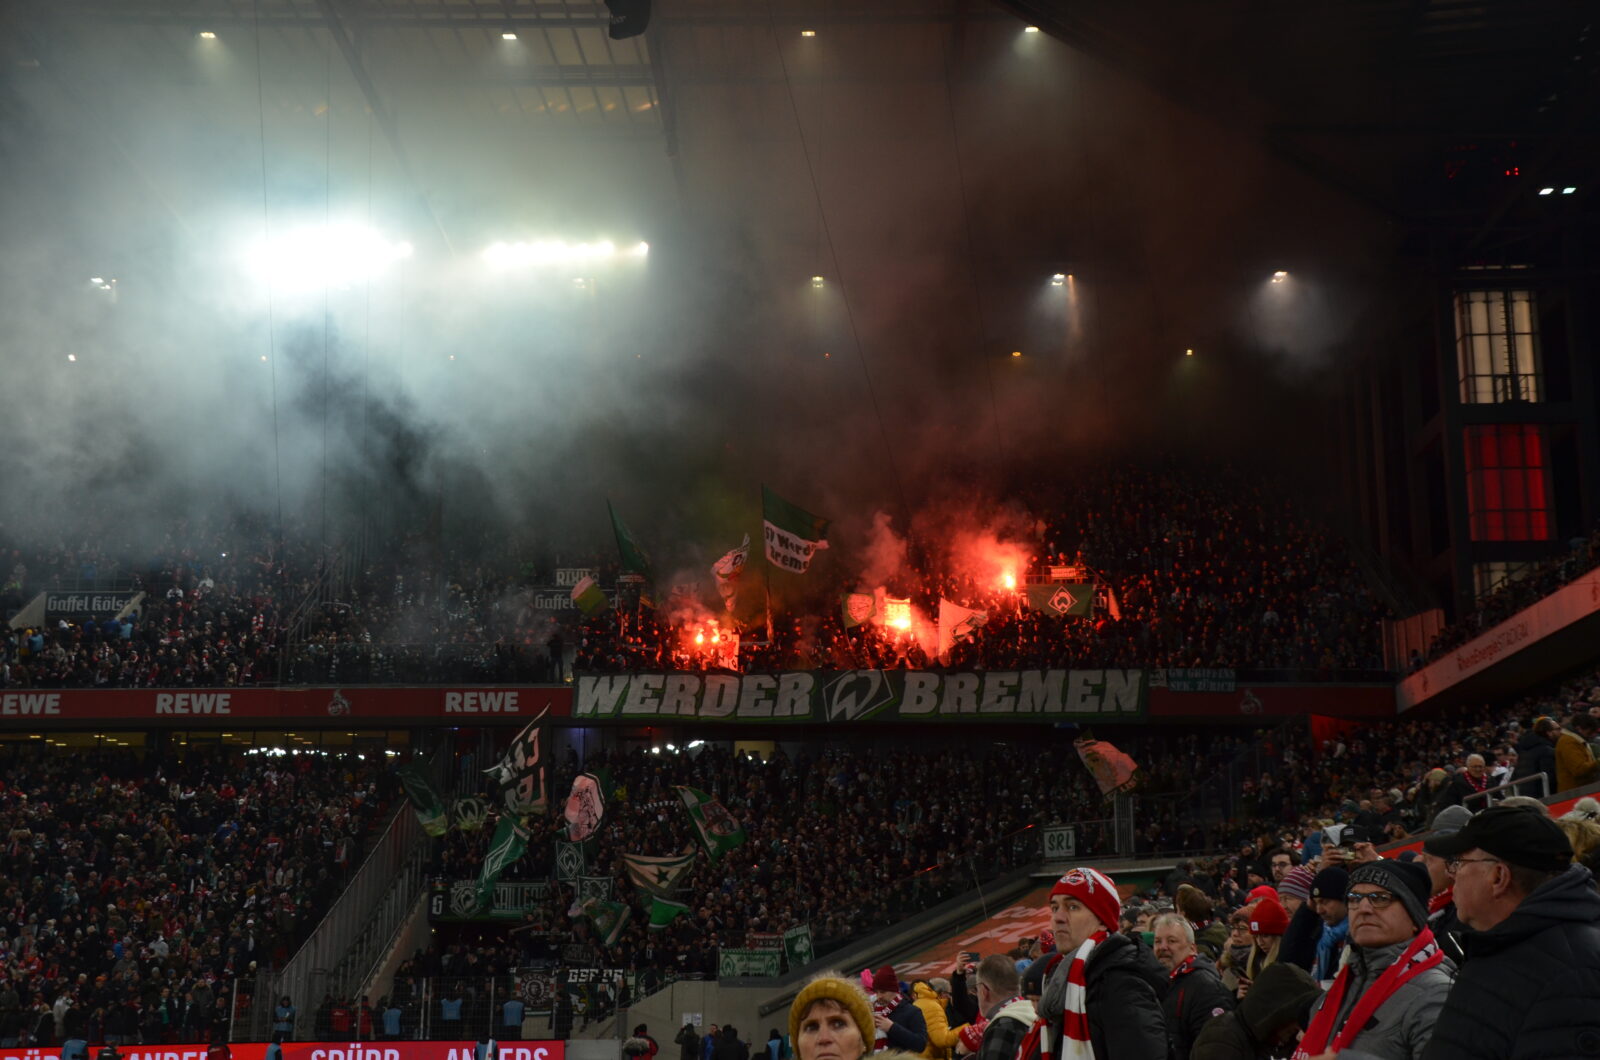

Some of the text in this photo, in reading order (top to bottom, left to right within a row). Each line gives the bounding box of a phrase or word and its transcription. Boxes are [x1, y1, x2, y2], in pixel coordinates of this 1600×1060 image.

[47, 595, 89, 612] Gaffel
[155, 693, 232, 714] REWE
[444, 691, 520, 713] REWE
[576, 672, 816, 717] WERDER
[898, 669, 1143, 714] BREMEN
[0, 693, 62, 715] EWE
[1048, 832, 1072, 851] SRL
